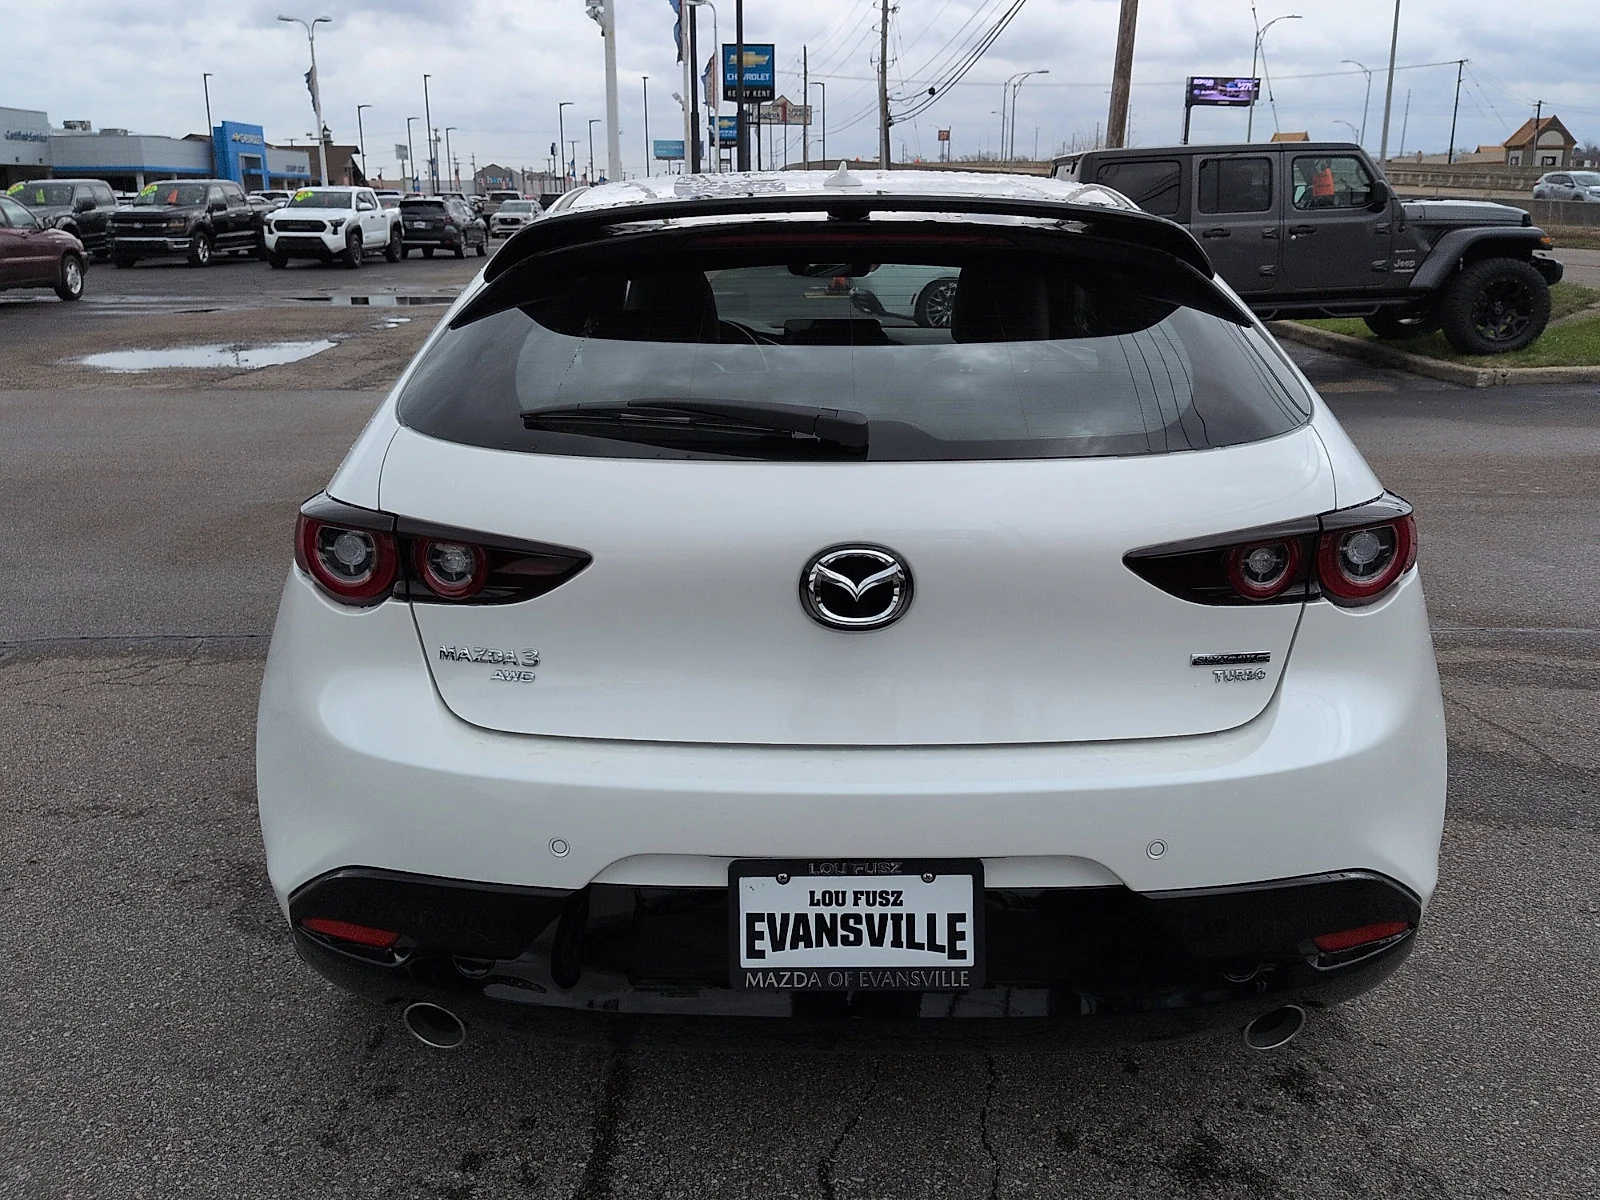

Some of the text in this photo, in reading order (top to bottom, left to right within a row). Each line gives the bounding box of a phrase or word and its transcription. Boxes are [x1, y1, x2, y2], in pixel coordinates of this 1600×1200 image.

[727, 73, 770, 81] CHVROLET
[727, 90, 770, 98] KENY KENT
[1394, 259, 1416, 268] Jeep
[490, 669, 536, 683] AWD
[1213, 668, 1266, 683] TURBO
[808, 861, 903, 875] LOU FUSZ
[808, 890, 904, 907] LOU FUSZ
[745, 912, 967, 960] EVANSVILLE
[745, 970, 970, 988] MAZDA OF EVANSVILLE
